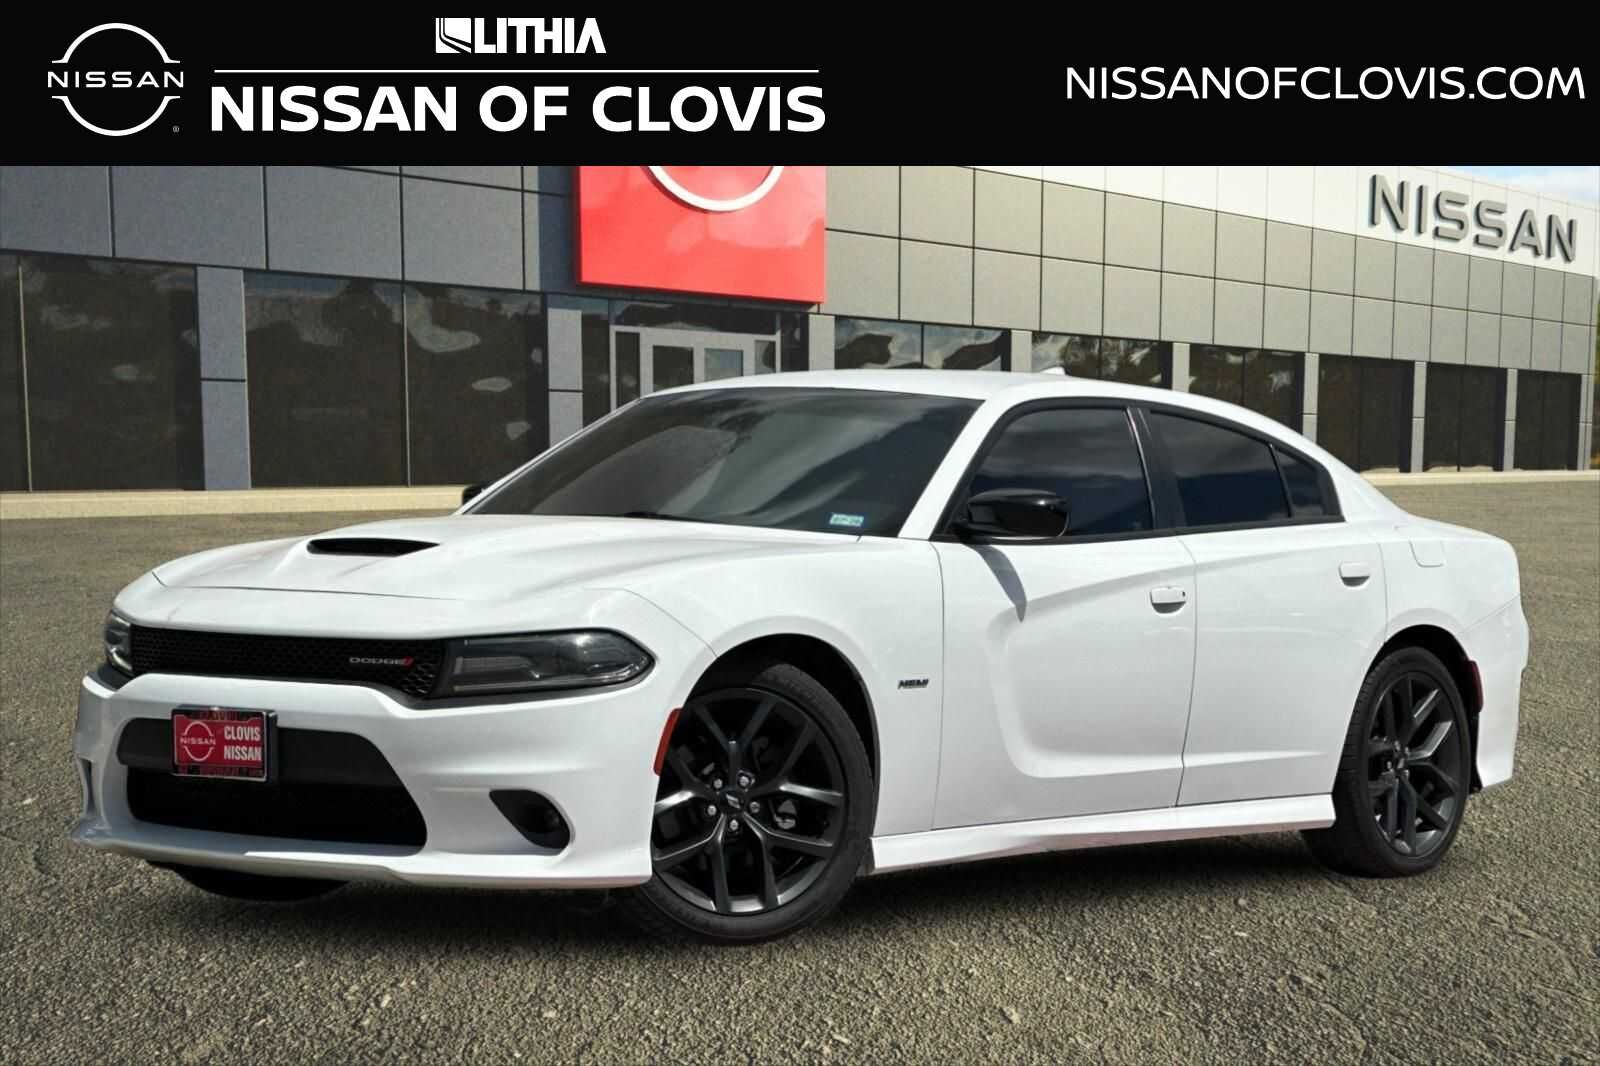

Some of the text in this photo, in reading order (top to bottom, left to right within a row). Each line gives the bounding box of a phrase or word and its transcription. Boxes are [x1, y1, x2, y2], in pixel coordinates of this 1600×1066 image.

[1369, 174, 1578, 262] NISSAN
[224, 725, 261, 742] CLOVIS
[223, 745, 262, 761] NISSAN
